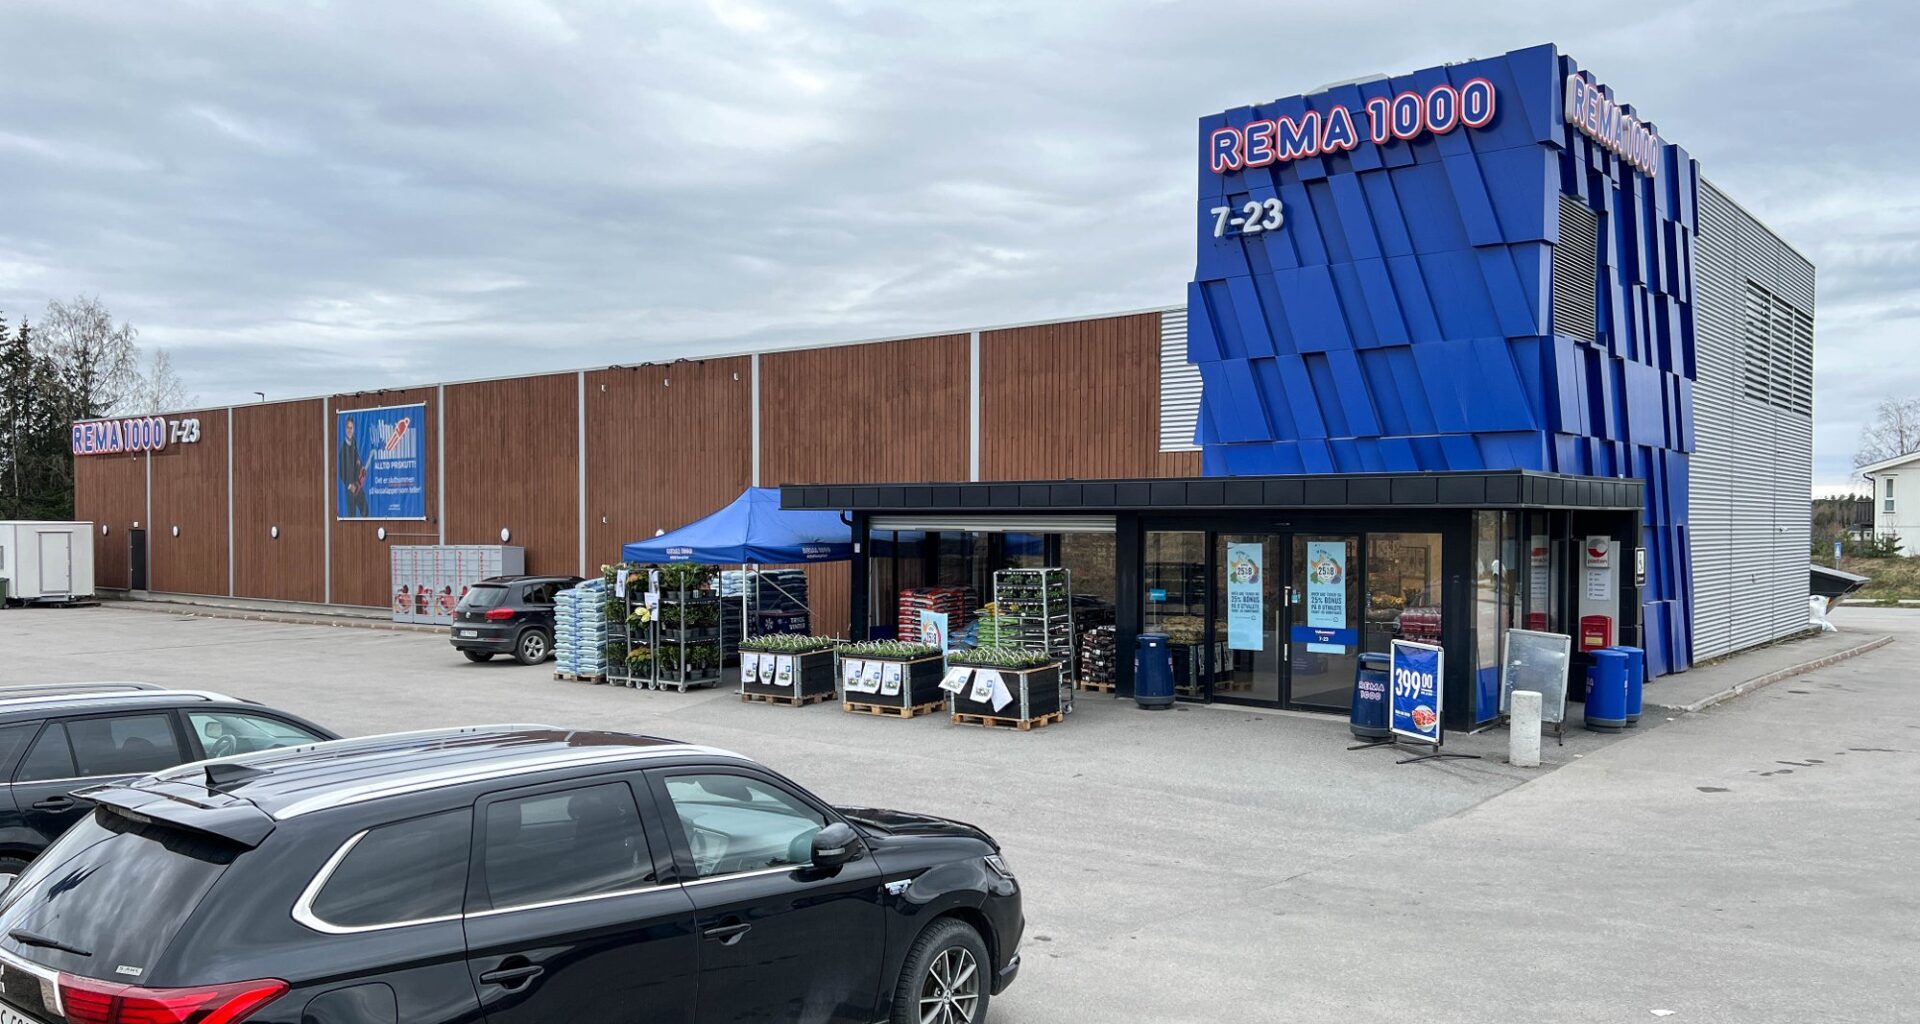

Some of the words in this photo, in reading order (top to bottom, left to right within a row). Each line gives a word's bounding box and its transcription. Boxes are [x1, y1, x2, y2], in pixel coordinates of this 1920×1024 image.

[1209, 105, 1358, 173] REMA
[1365, 77, 1496, 145] 1000
[1567, 73, 1623, 154] REMA
[1622, 114, 1659, 178] 1000
[1210, 198, 1284, 238] 7-23
[72, 421, 123, 455] REMA
[122, 417, 166, 452] 1000
[169, 418, 200, 443] 7-23
[1311, 596, 1323, 604] 25%
[1324, 597, 1342, 605] BONUS
[1358, 681, 1385, 692] REMA
[1360, 690, 1382, 701] 1000
[1395, 668, 1421, 699] 399
